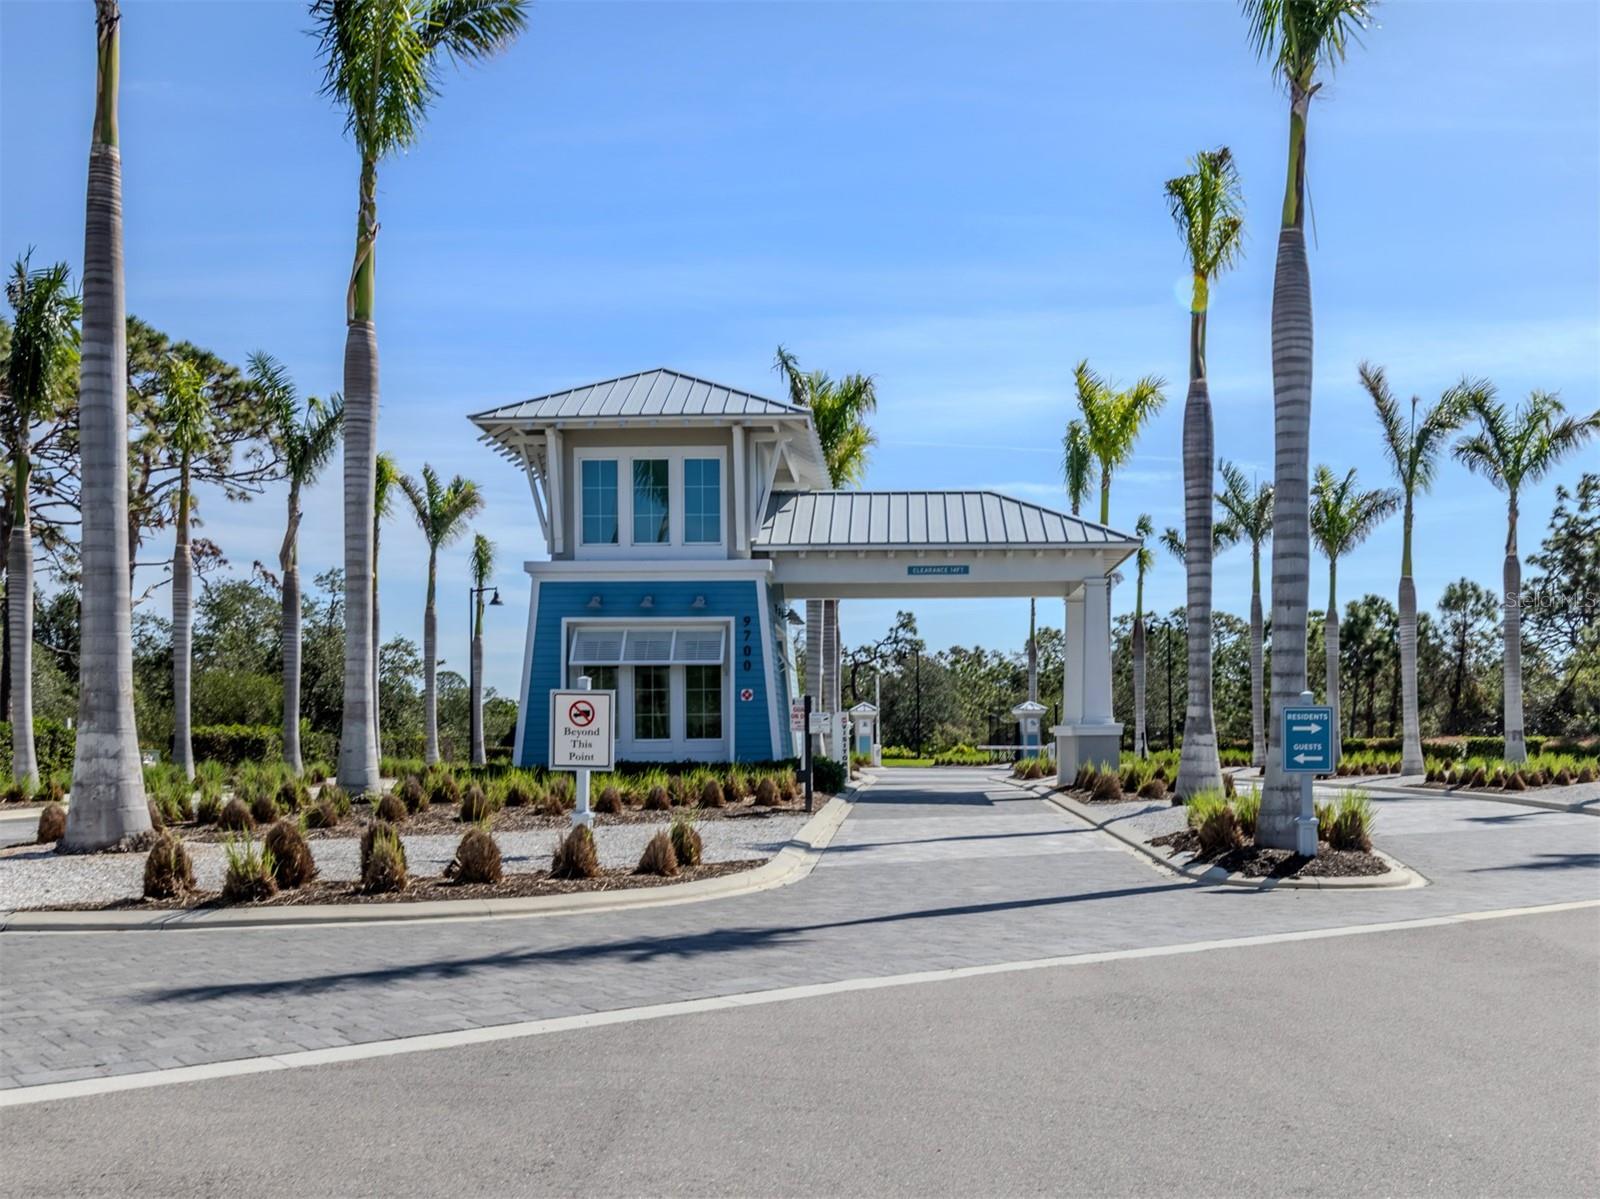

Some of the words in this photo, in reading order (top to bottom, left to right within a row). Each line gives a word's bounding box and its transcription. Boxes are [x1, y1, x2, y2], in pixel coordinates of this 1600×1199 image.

[743, 615, 752, 672] 9700
[1287, 713, 1328, 721] RESIDENTS
[564, 727, 600, 738] Beyond
[570, 739, 593, 748] This
[1293, 743, 1322, 751] GUESTS
[569, 752, 595, 761] Point
